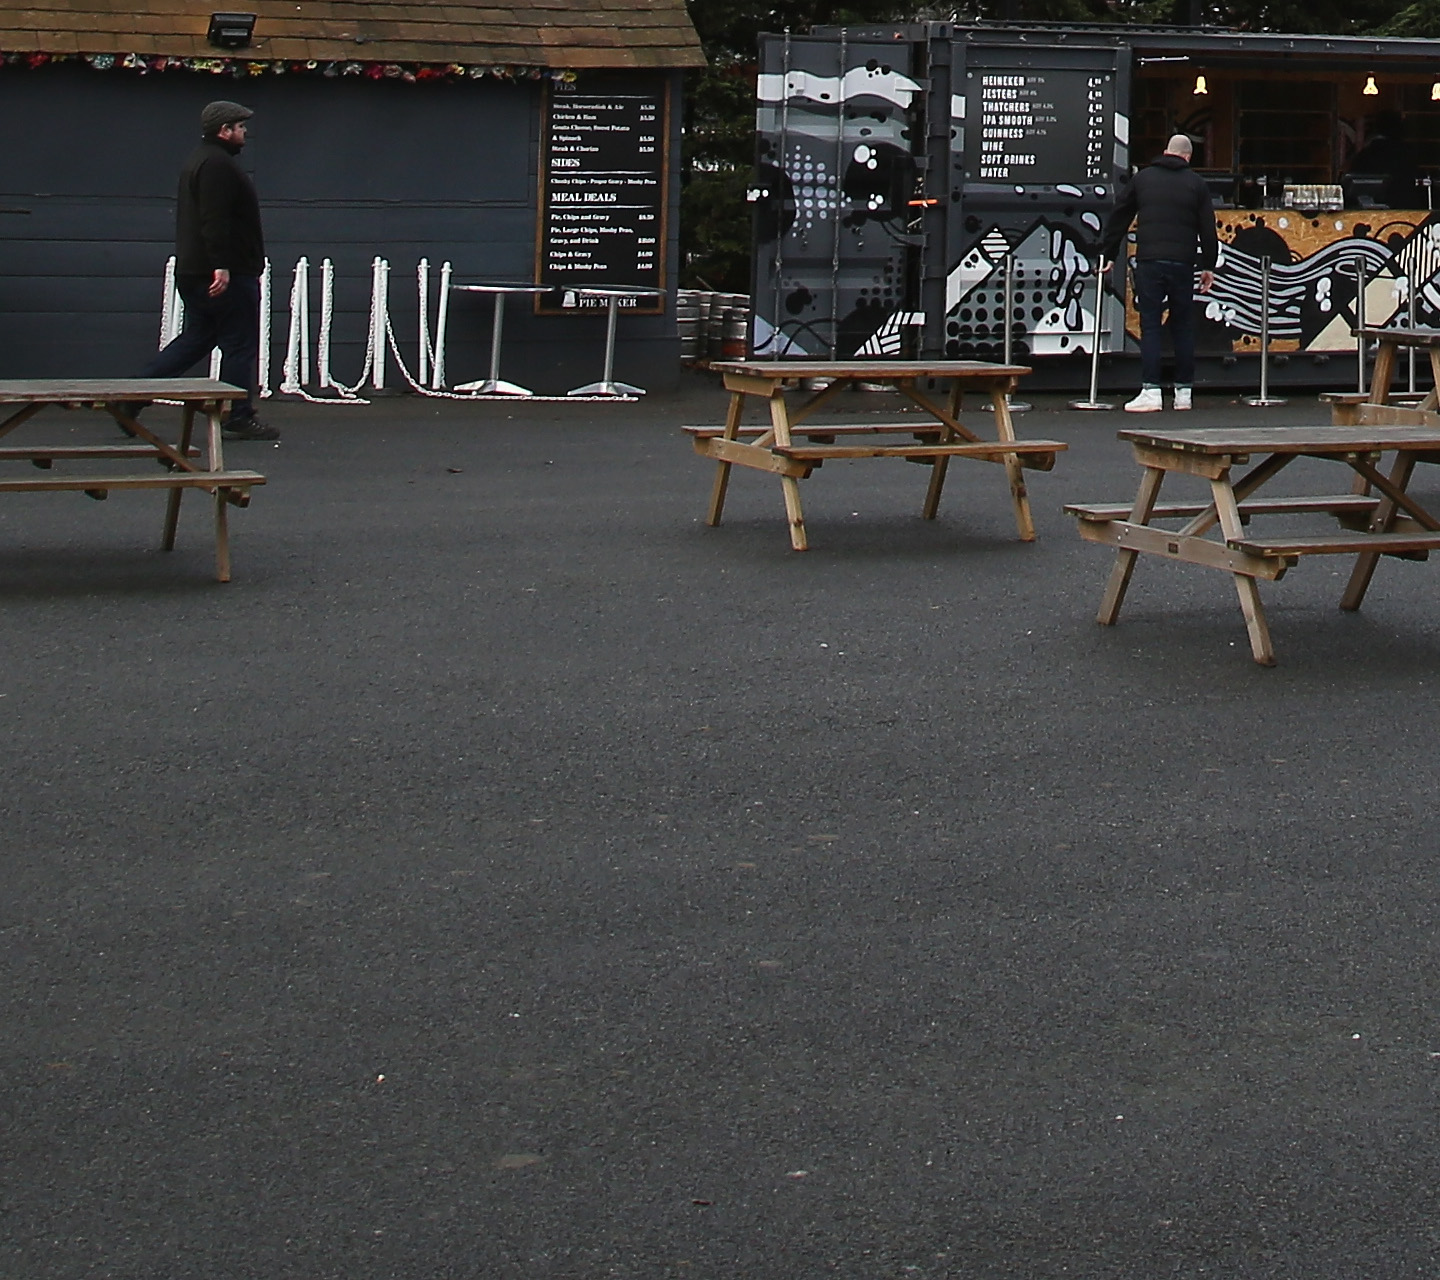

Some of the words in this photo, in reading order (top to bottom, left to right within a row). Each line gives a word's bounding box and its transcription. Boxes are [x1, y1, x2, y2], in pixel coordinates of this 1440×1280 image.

[982, 76, 1025, 87] HEINEKEN
[982, 89, 1017, 99] JESTERS
[983, 102, 1030, 112] THATCHERS
[983, 115, 996, 125] IPA
[999, 116, 1033, 126] SMOOTH
[983, 129, 1024, 138] GUINNESS
[982, 142, 1004, 151] WINE
[551, 158, 580, 167] SIDES
[981, 155, 1001, 164] SOFT
[1004, 155, 1036, 165] DRINKS
[980, 168, 1009, 178] WATER
[551, 193, 582, 202] MEAL
[583, 193, 617, 202] DEALS
[579, 298, 597, 308] PIE
[599, 298, 637, 308] MKER
